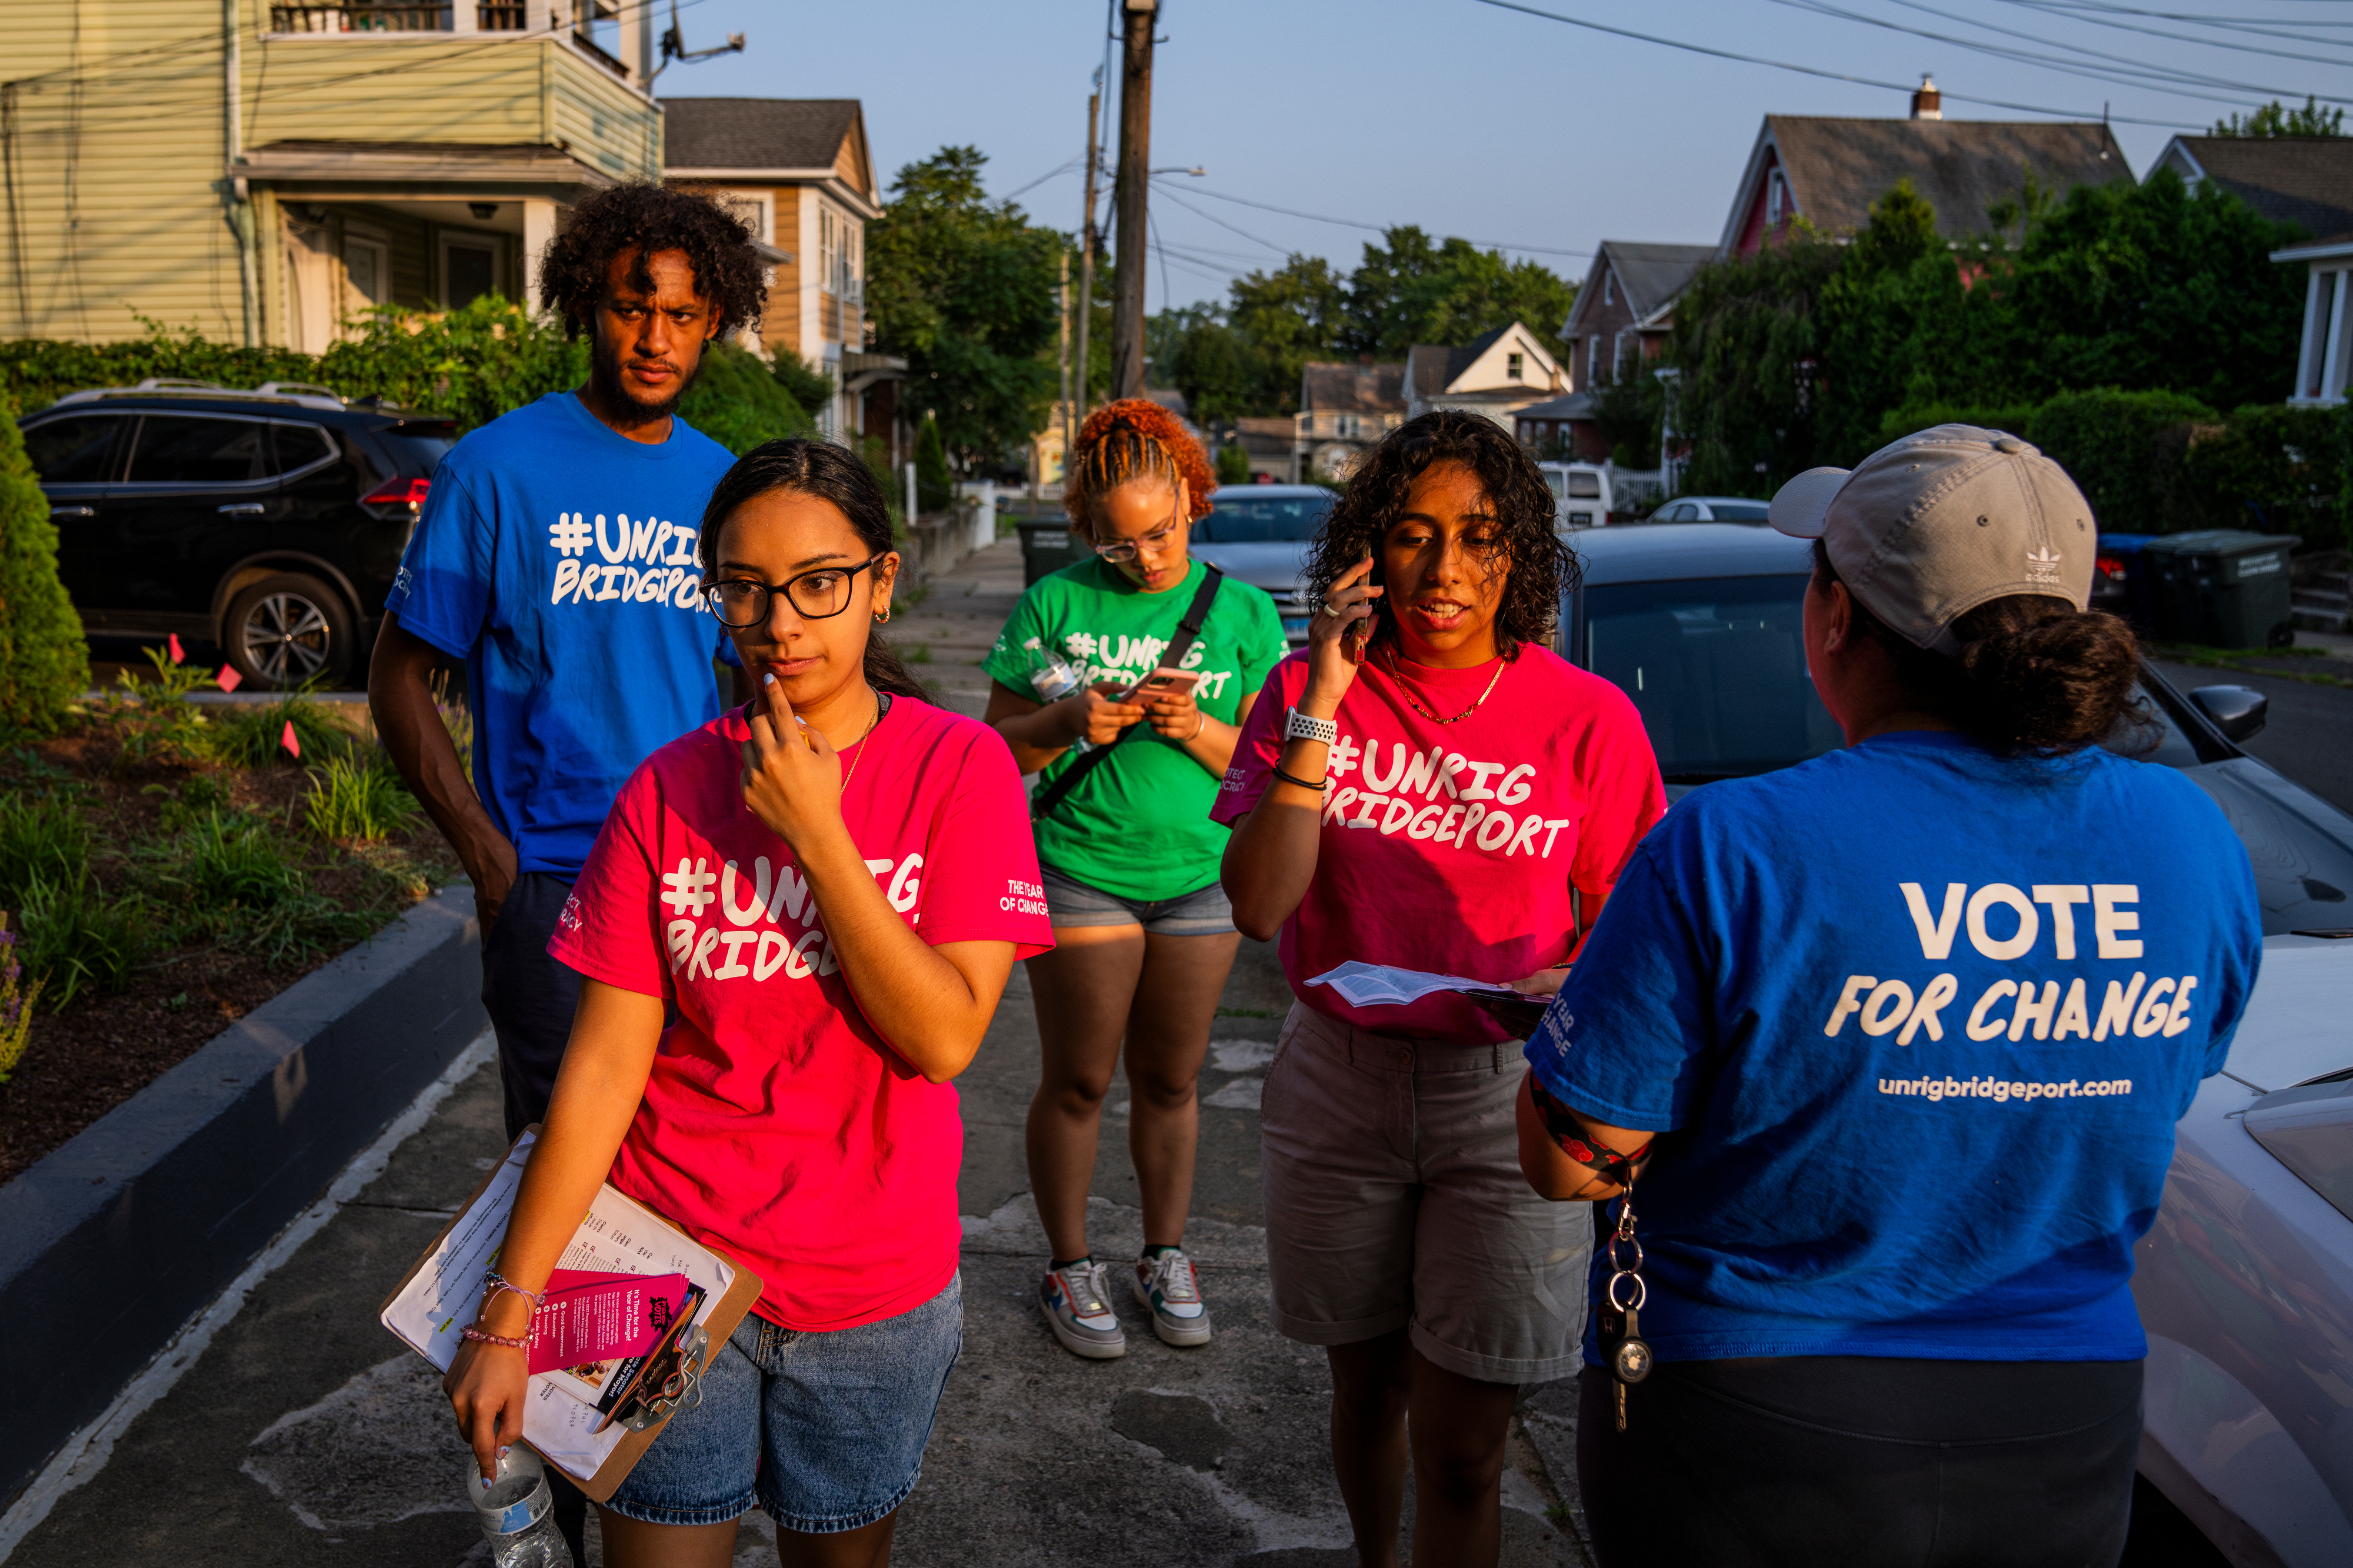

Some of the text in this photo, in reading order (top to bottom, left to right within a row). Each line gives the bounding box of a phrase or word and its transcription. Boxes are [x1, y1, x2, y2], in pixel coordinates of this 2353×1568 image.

[2025, 572, 2059, 583] adidas
[551, 559, 711, 613] BRIDGEPO
[1065, 632, 1206, 670] #UNRG
[1325, 735, 1536, 806] #UNRIG
[1008, 879, 1044, 899] THE YEAR
[999, 897, 1015, 911] OF
[1898, 882, 2144, 960] VOTE
[1553, 992, 1574, 1033] YEAR
[1824, 971, 2198, 1046] FOR CHANGE
[1540, 1007, 1572, 1057] HANGE
[1878, 1076, 2132, 1102] unrigbridgeport.com
[495, 1213, 508, 1229] [VOTER
[484, 1227, 496, 1242] NAME].
[471, 1249, 481, 1260] thank
[452, 1270, 464, 1283] voting
[442, 1286, 452, 1298] Tues.
[461, 1288, 475, 1305] question
[434, 1296, 444, 1307] Sept
[427, 1305, 436, 1316] 12th!
[451, 1308, 459, 1317] you.
[438, 1323, 447, 1333] you
[445, 1316, 453, 1325] Will
[624, 1313, 632, 1340] Change!
[621, 1363, 631, 1374] for
[539, 1381, 552, 1397] VOTER
[608, 1373, 625, 1397] Mayor!
[615, 1368, 635, 1395] Senator
[542, 1385, 555, 1401] VOTES
